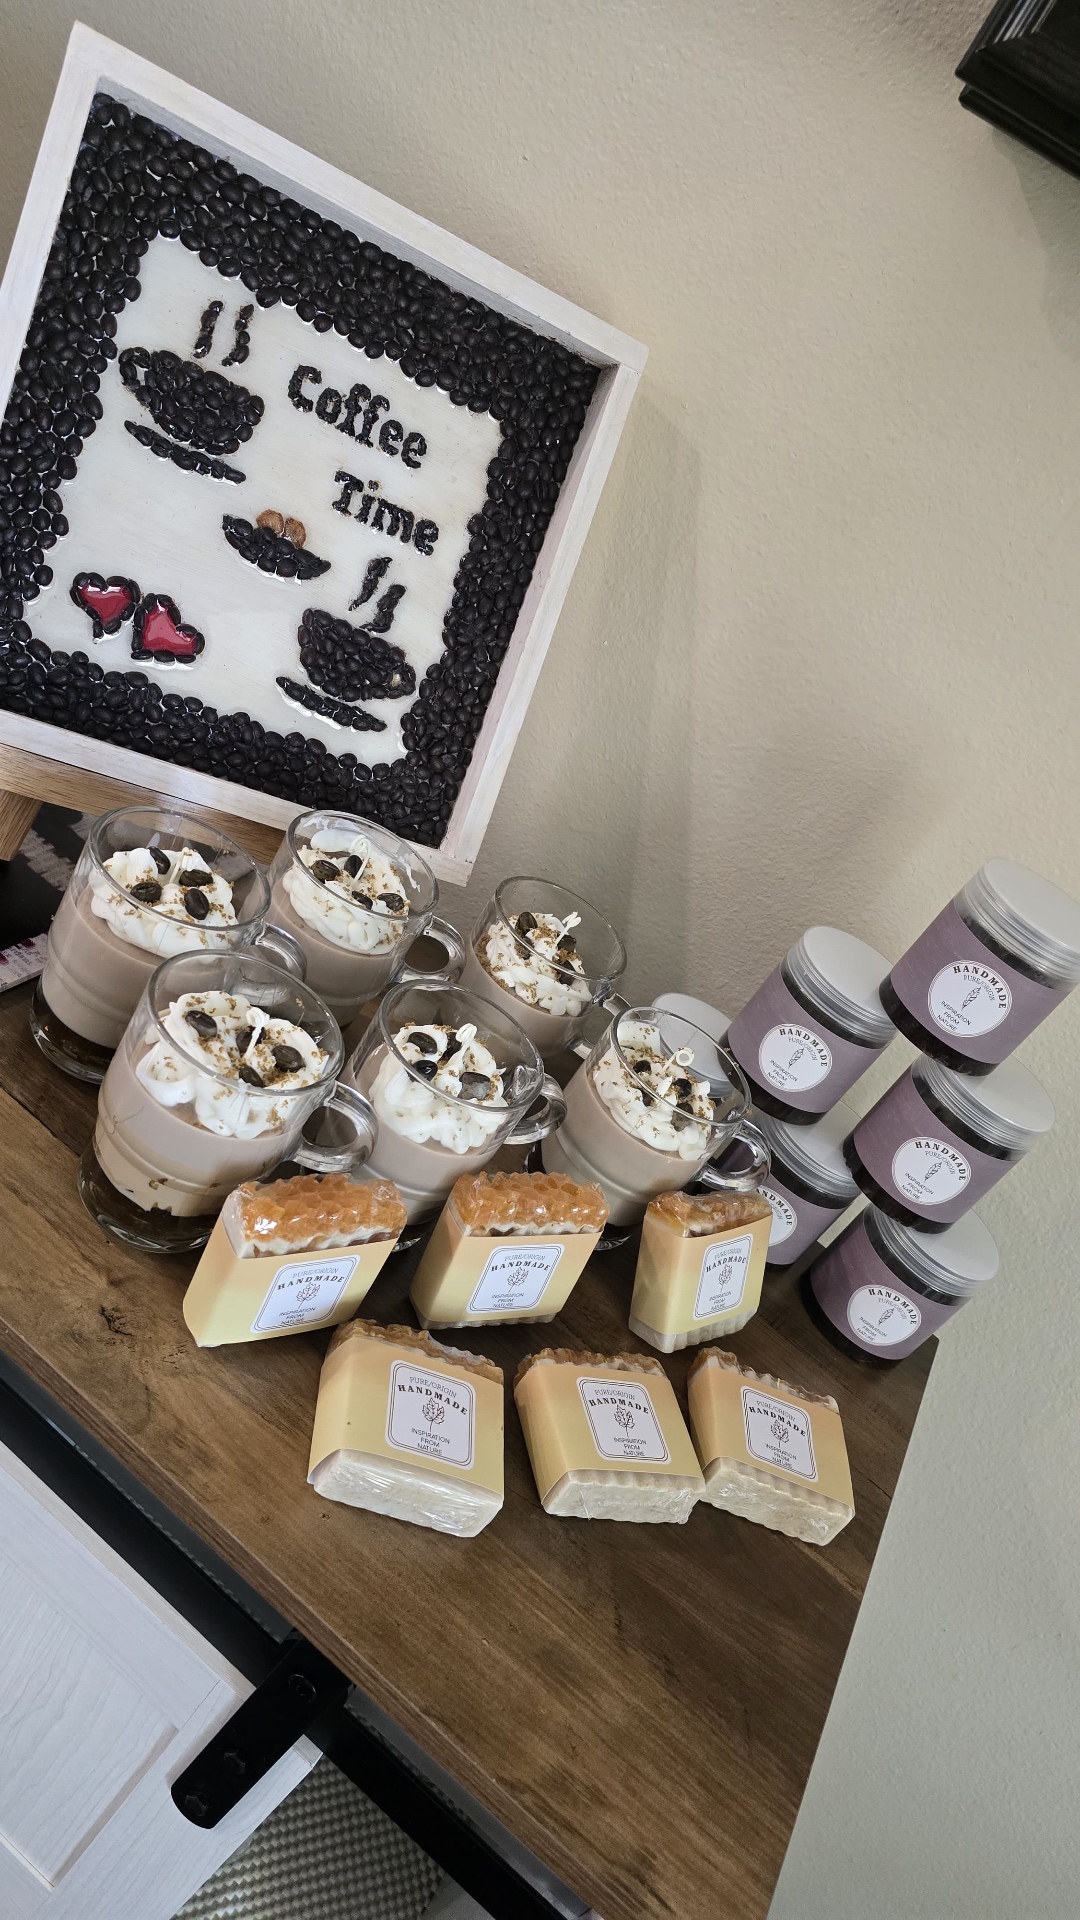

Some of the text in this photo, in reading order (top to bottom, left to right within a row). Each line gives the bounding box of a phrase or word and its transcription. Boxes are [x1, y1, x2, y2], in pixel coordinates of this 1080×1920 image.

[288, 365, 427, 468] Coffee
[332, 470, 439, 555] Time
[953, 965, 1006, 1009] HANDMADE
[940, 1001, 971, 1025] INSPIRATION
[944, 1011, 959, 1025] FROM
[937, 1015, 957, 1031] NATURE
[779, 1028, 828, 1067] HANDMADE
[770, 1060, 798, 1082] INSPIRATION
[773, 1069, 787, 1081] FROM
[915, 1141, 966, 1180] HANDMADE
[902, 1185, 921, 1199] NATURE
[905, 1172, 934, 1195] INSPIRATION
[907, 1182, 923, 1194] FROM
[756, 1188, 793, 1225] ANDMADE
[491, 1260, 551, 1272] HANDMADE
[706, 1256, 746, 1272] HANDMADE
[293, 1268, 339, 1278] PURE/ORIGIN
[277, 1275, 345, 1290] HANDMADE
[279, 1307, 316, 1316] INSPIRATION
[868, 1289, 917, 1325] HANDMADE
[862, 1326, 877, 1337] FROM
[409, 1376, 457, 1398] PURE/ORIGIN
[398, 1385, 468, 1415] HANDMADE
[588, 1397, 649, 1414] HANDMADE
[748, 1406, 806, 1437] HANDMADE
[411, 1427, 450, 1444] INSPIRATION
[421, 1437, 440, 1447] FROM
[417, 1443, 443, 1454] NATURE
